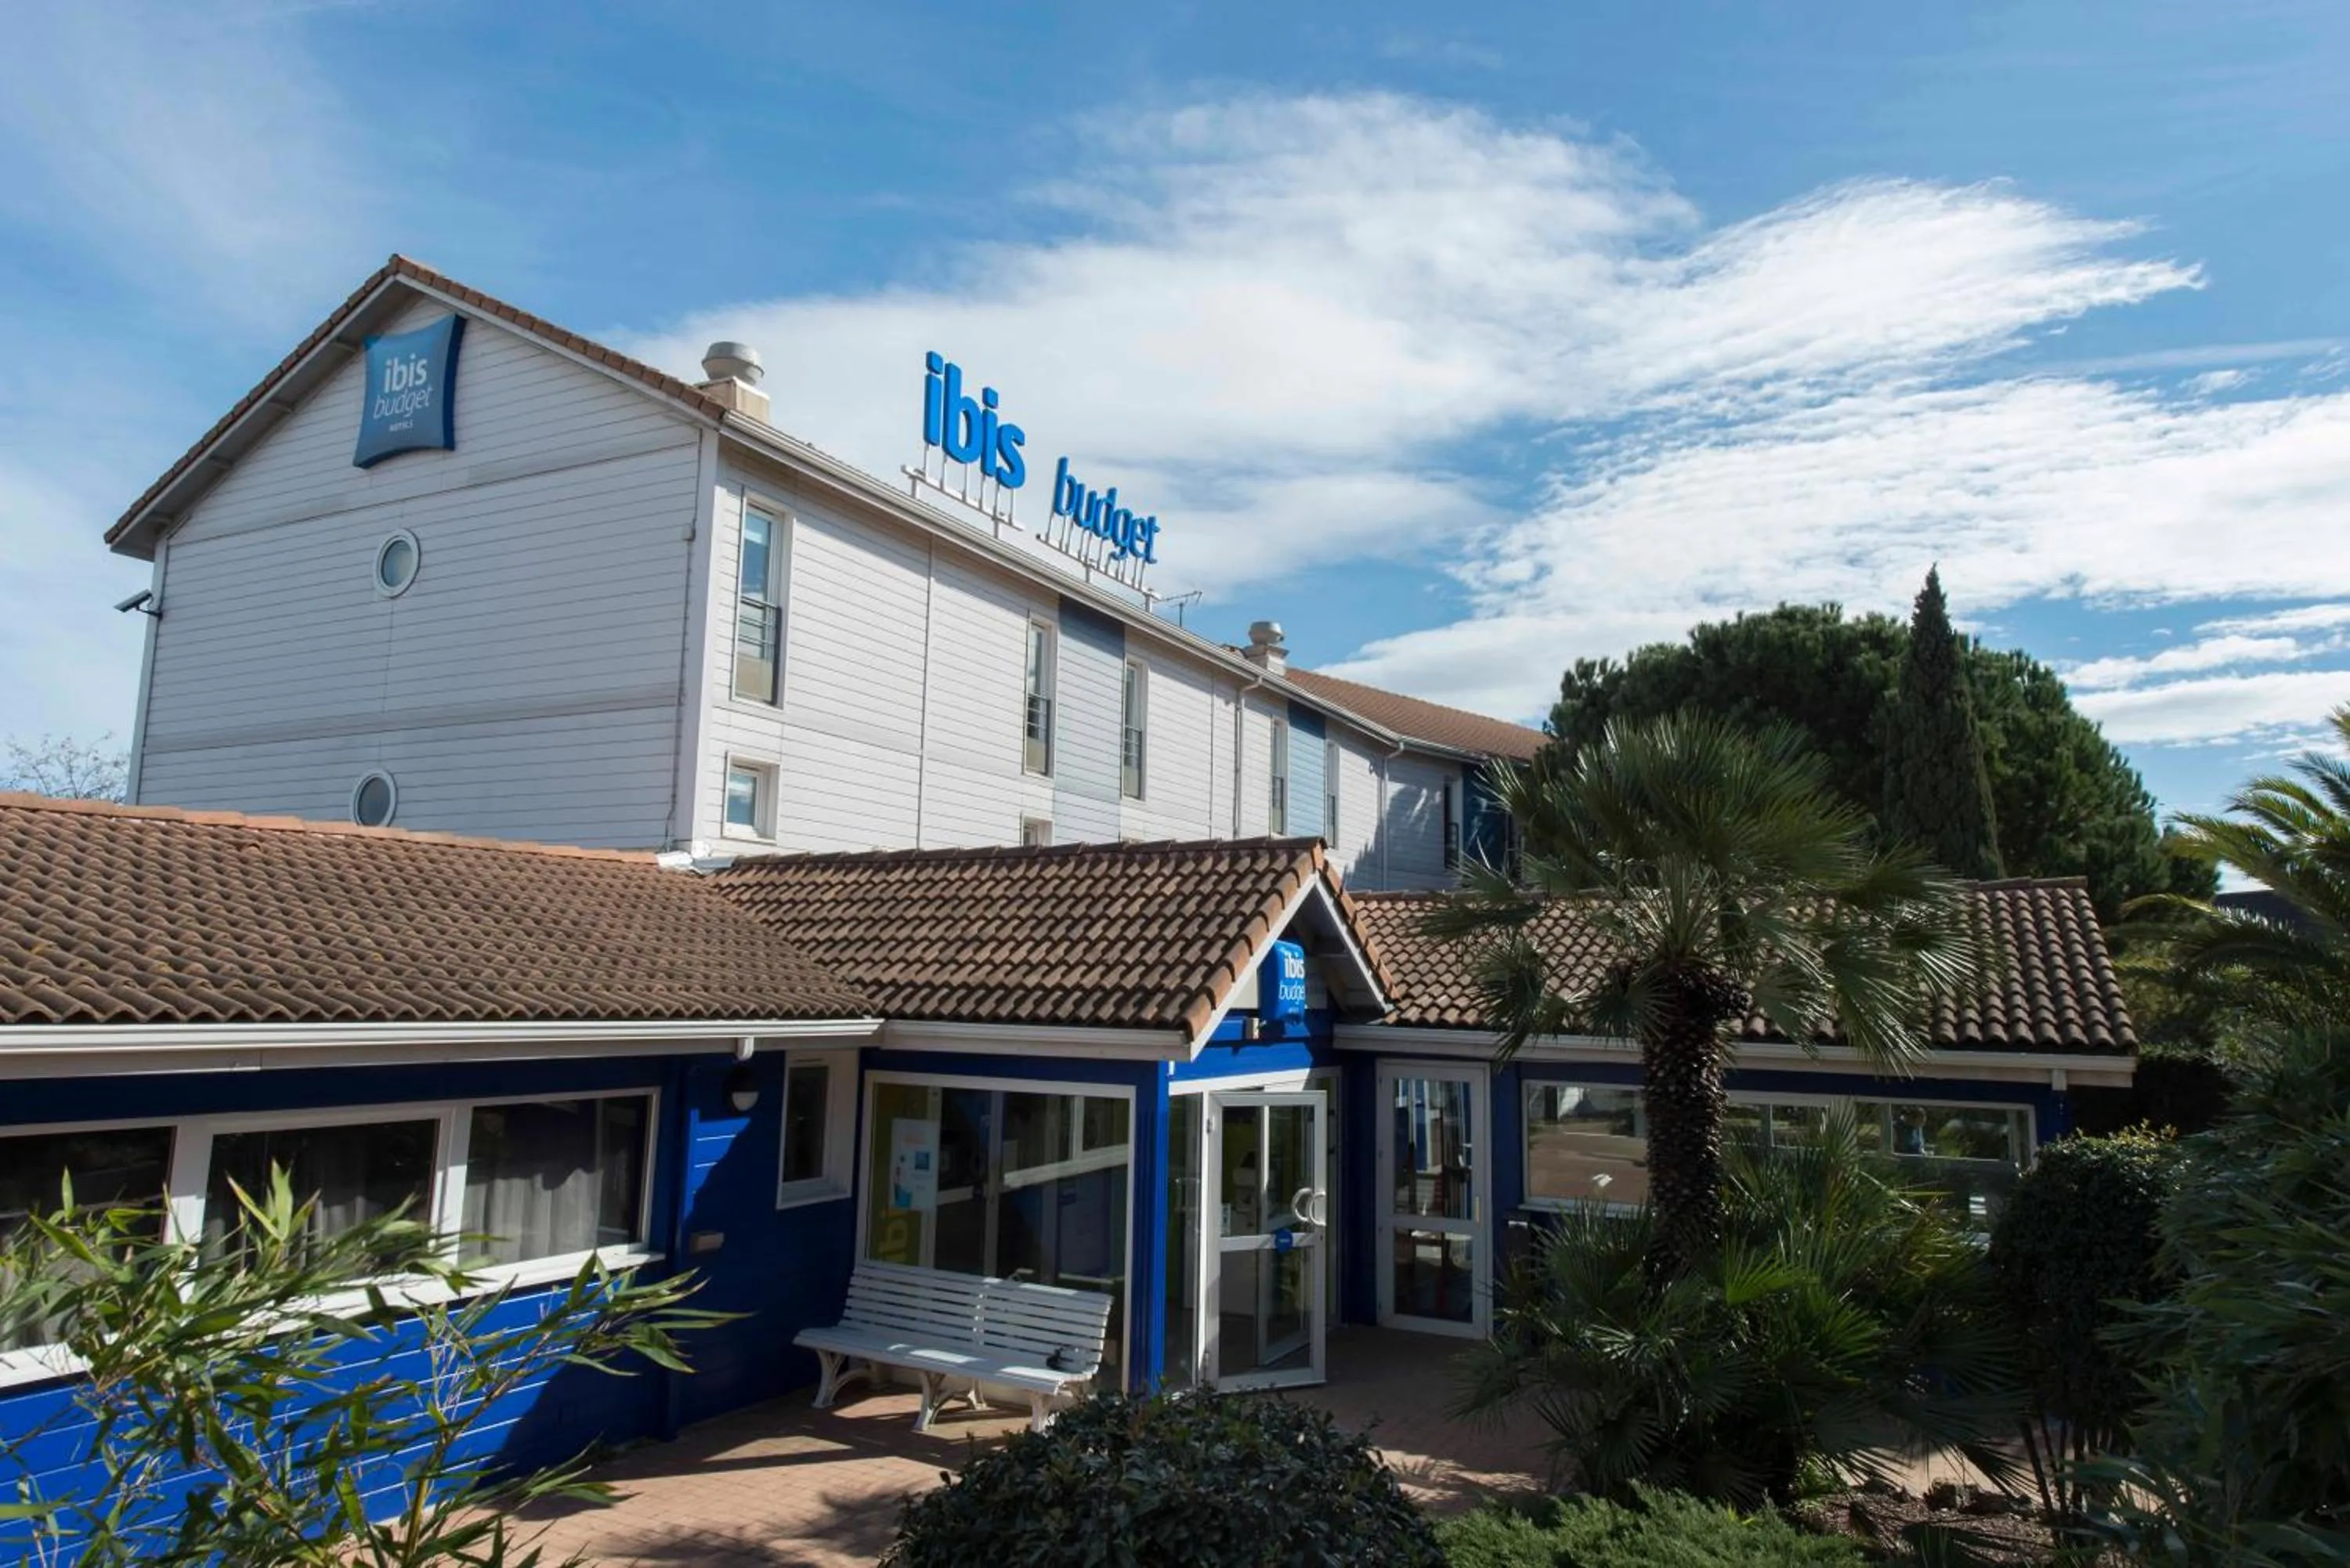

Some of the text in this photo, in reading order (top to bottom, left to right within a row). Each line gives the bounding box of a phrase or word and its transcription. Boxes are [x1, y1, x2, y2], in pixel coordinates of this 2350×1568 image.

[385, 353, 428, 393] ibis
[373, 387, 433, 419] budget
[923, 350, 1160, 565] ibis budget
[1284, 951, 1306, 979] ibis
[1278, 980, 1307, 1005] budge
